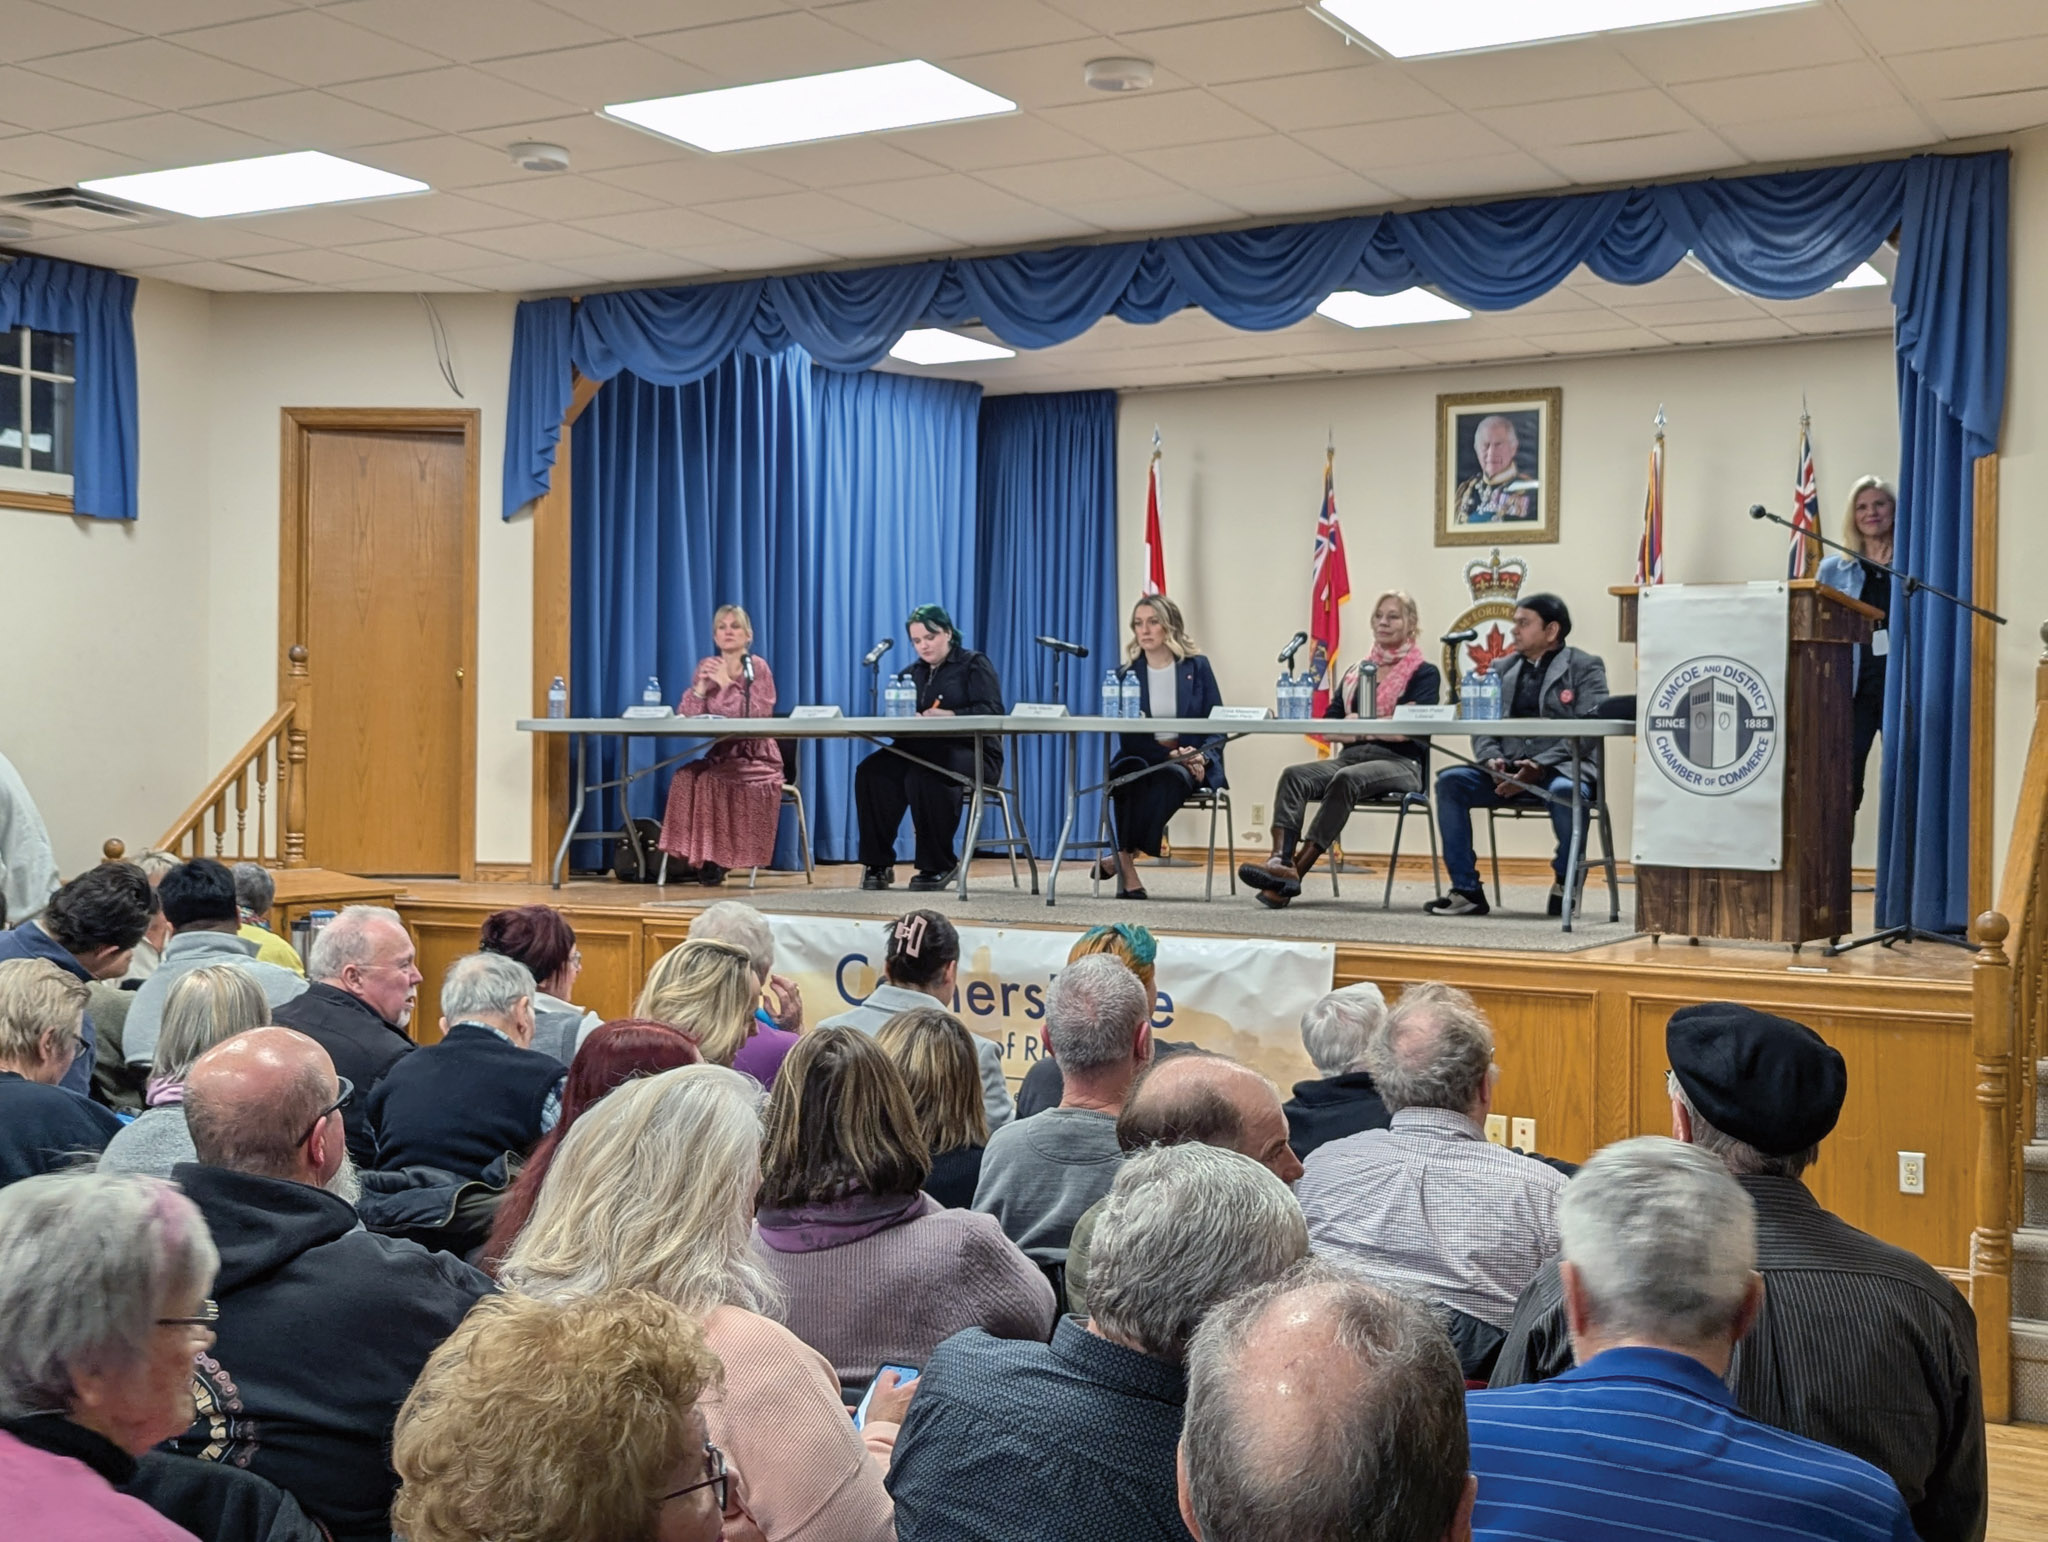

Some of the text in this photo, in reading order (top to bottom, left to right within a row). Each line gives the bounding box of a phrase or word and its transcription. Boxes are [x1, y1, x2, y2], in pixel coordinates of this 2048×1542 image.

[1659, 665, 1767, 711] SIMCOE AND DISTRICT
[1655, 718, 1768, 728] SINCE 1888
[1656, 736, 1768, 786] CHAMBER OF COMMERCE
